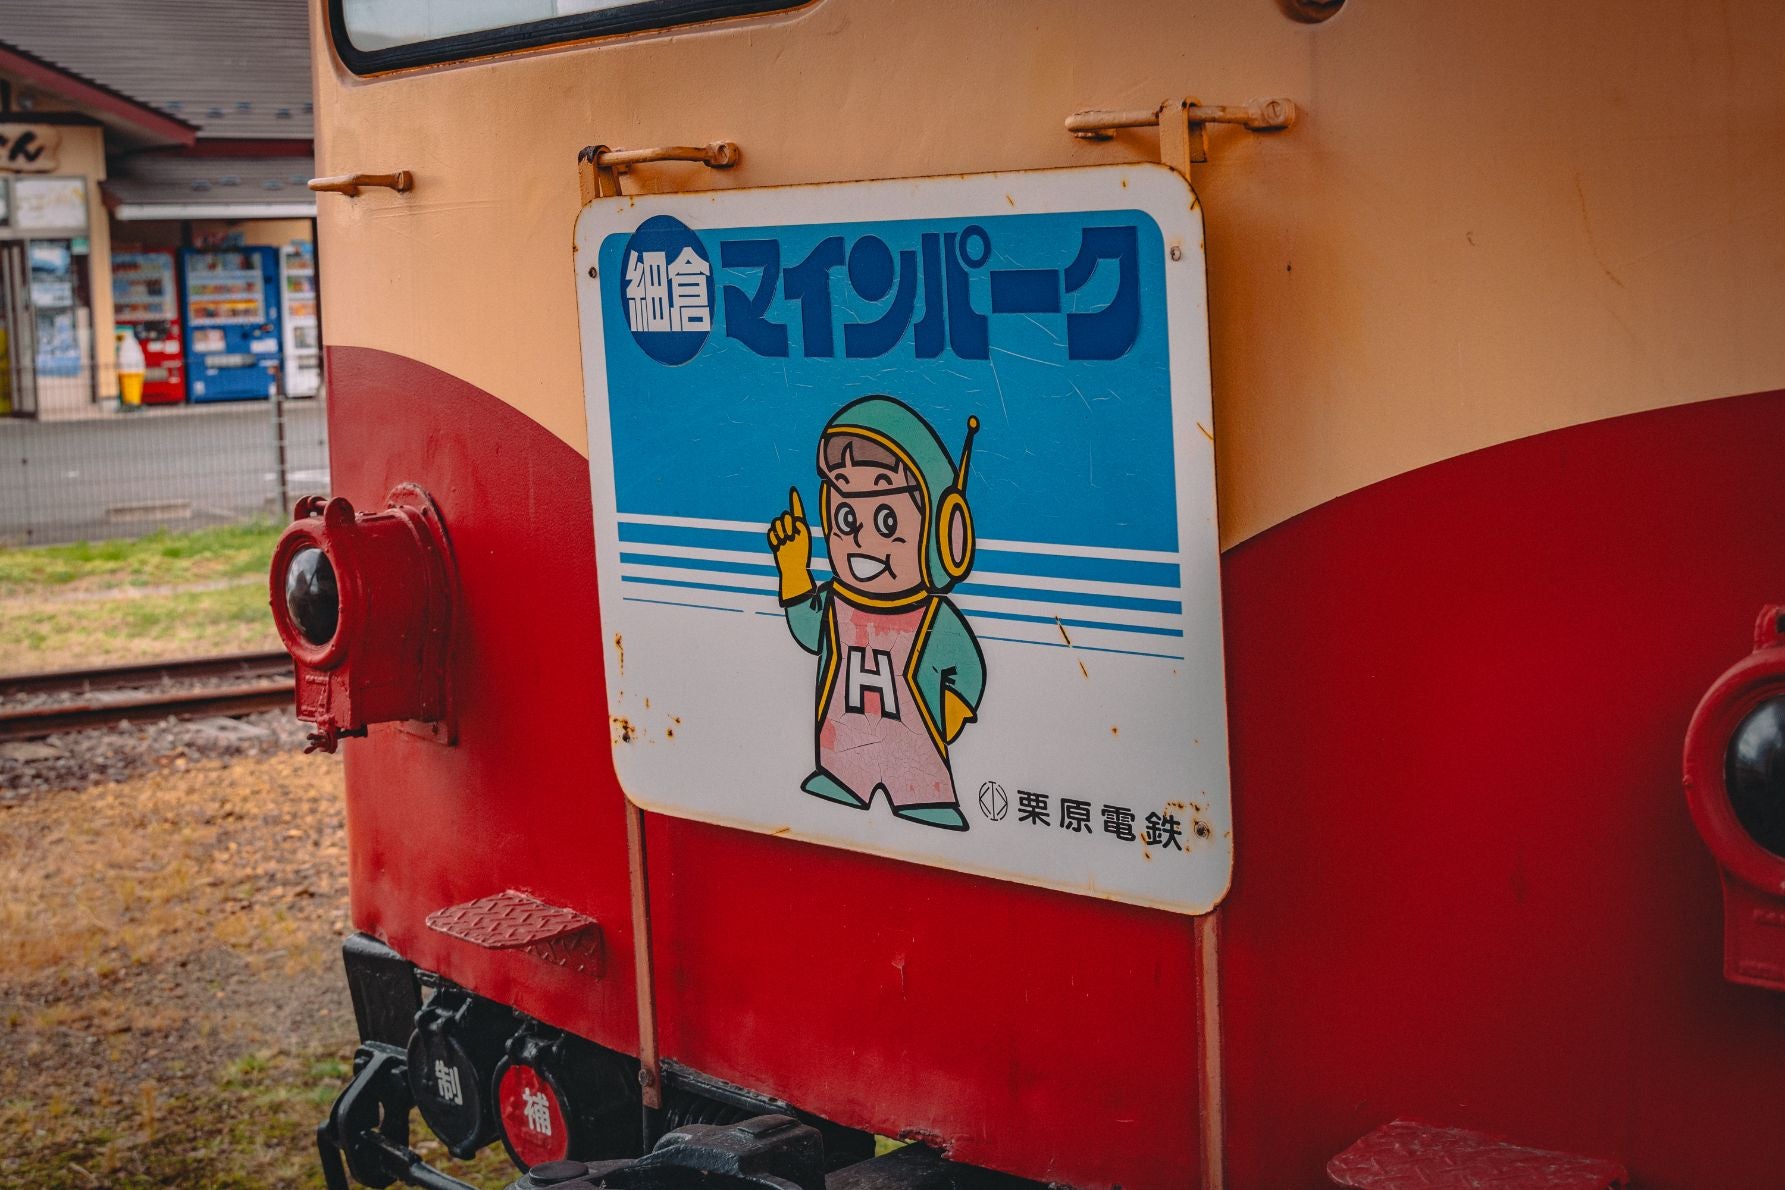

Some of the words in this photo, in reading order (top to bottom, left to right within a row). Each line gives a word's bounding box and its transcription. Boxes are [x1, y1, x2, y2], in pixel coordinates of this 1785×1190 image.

[0, 130, 45, 162] ん
[625, 246, 711, 332] 細倉
[720, 225, 1139, 361] マインパーク
[844, 645, 901, 722] H
[1016, 789, 1183, 851] 栗原電鉄
[435, 1059, 463, 1105] 制
[522, 1087, 552, 1136] 補
